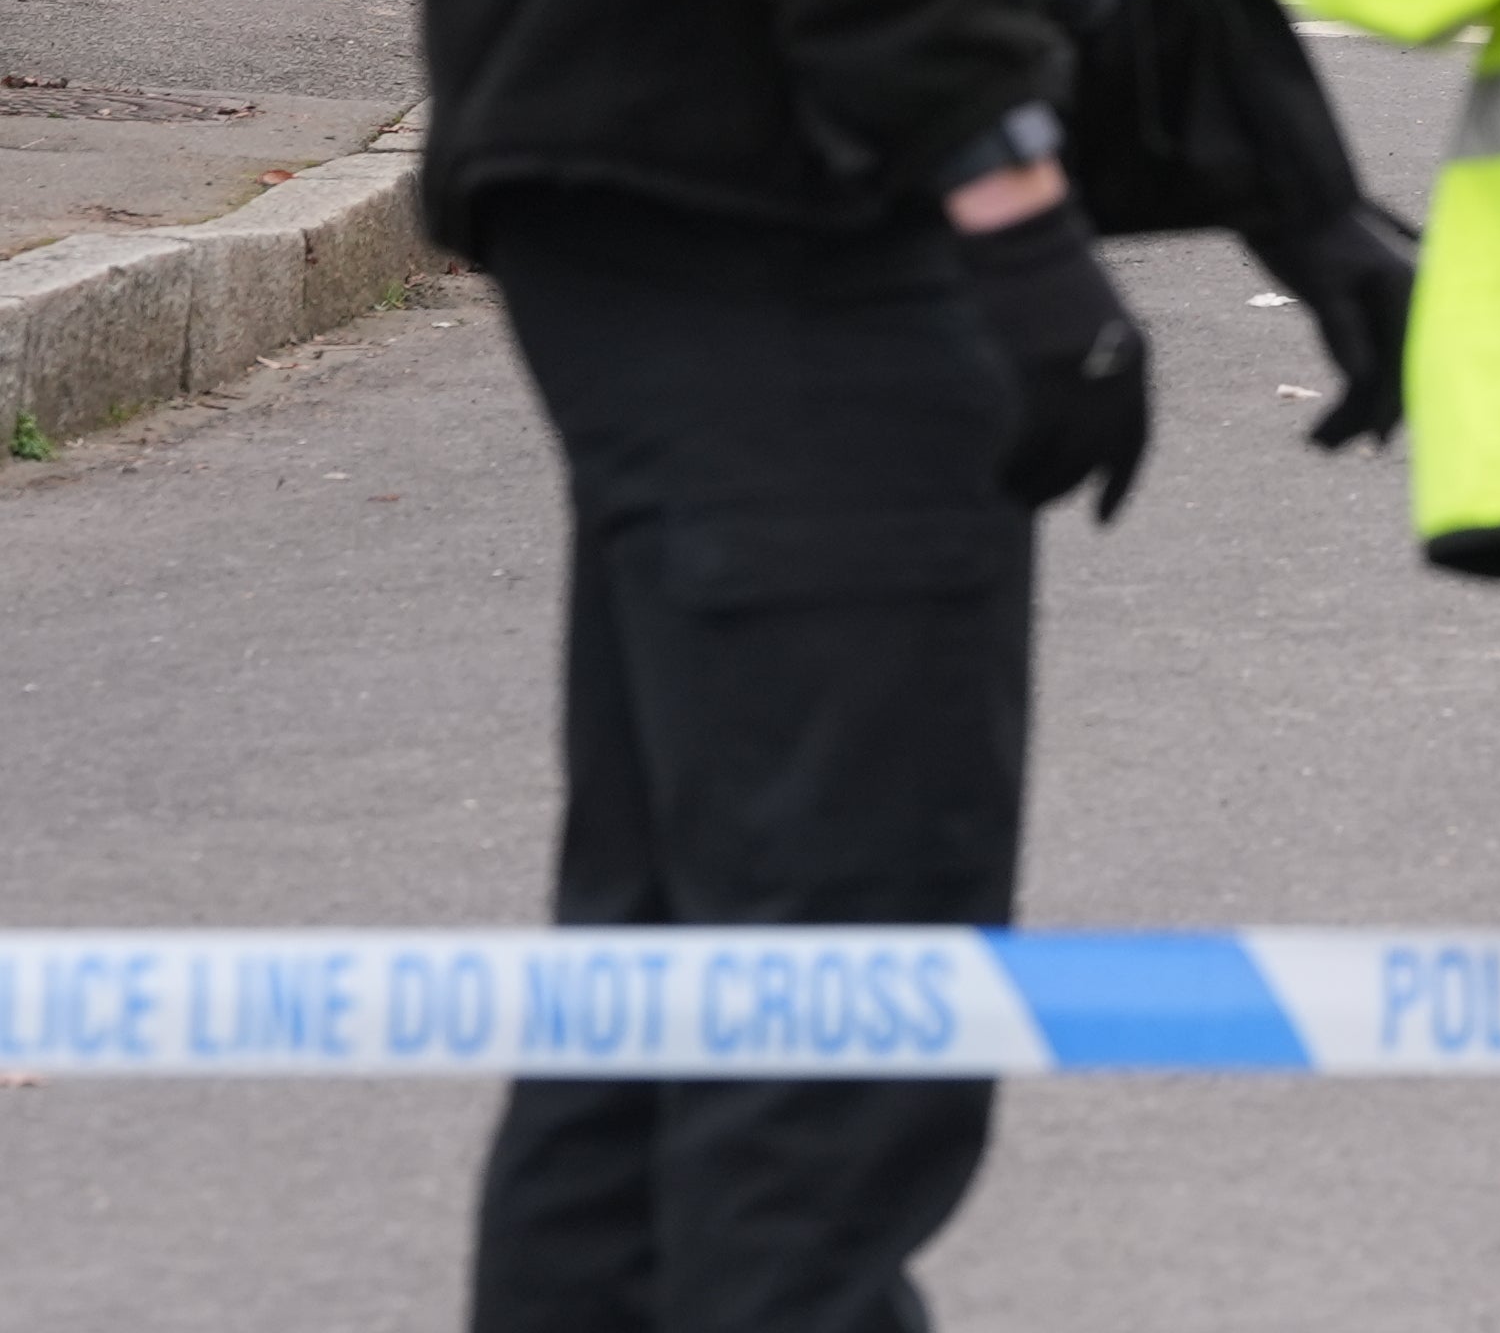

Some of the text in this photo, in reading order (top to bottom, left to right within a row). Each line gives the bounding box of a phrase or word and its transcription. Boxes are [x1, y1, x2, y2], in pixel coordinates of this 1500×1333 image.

[0, 950, 958, 1057] LICE LINE DO NOT CROSS
